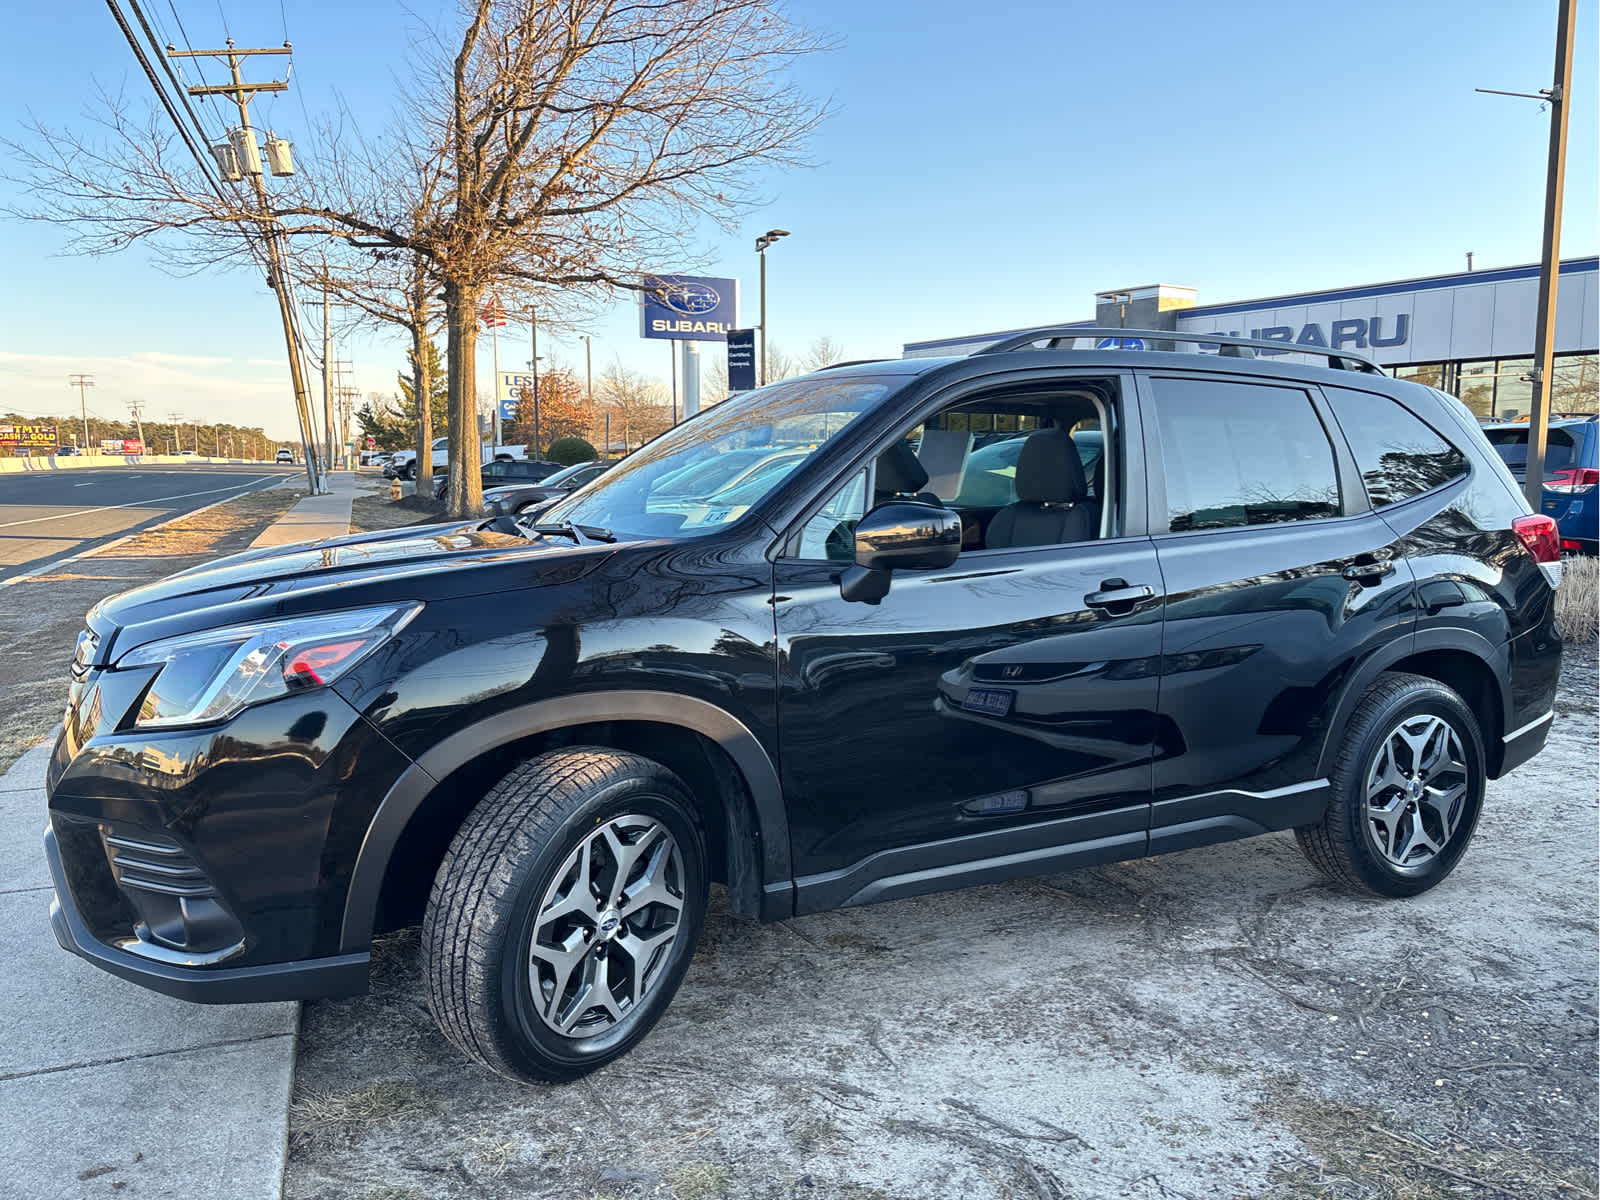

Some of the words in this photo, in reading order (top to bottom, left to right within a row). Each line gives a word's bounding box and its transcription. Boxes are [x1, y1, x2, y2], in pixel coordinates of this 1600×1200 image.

[652, 319, 731, 334] SUBARU
[1199, 313, 1409, 357] BARU
[13, 425, 40, 433] TMT
